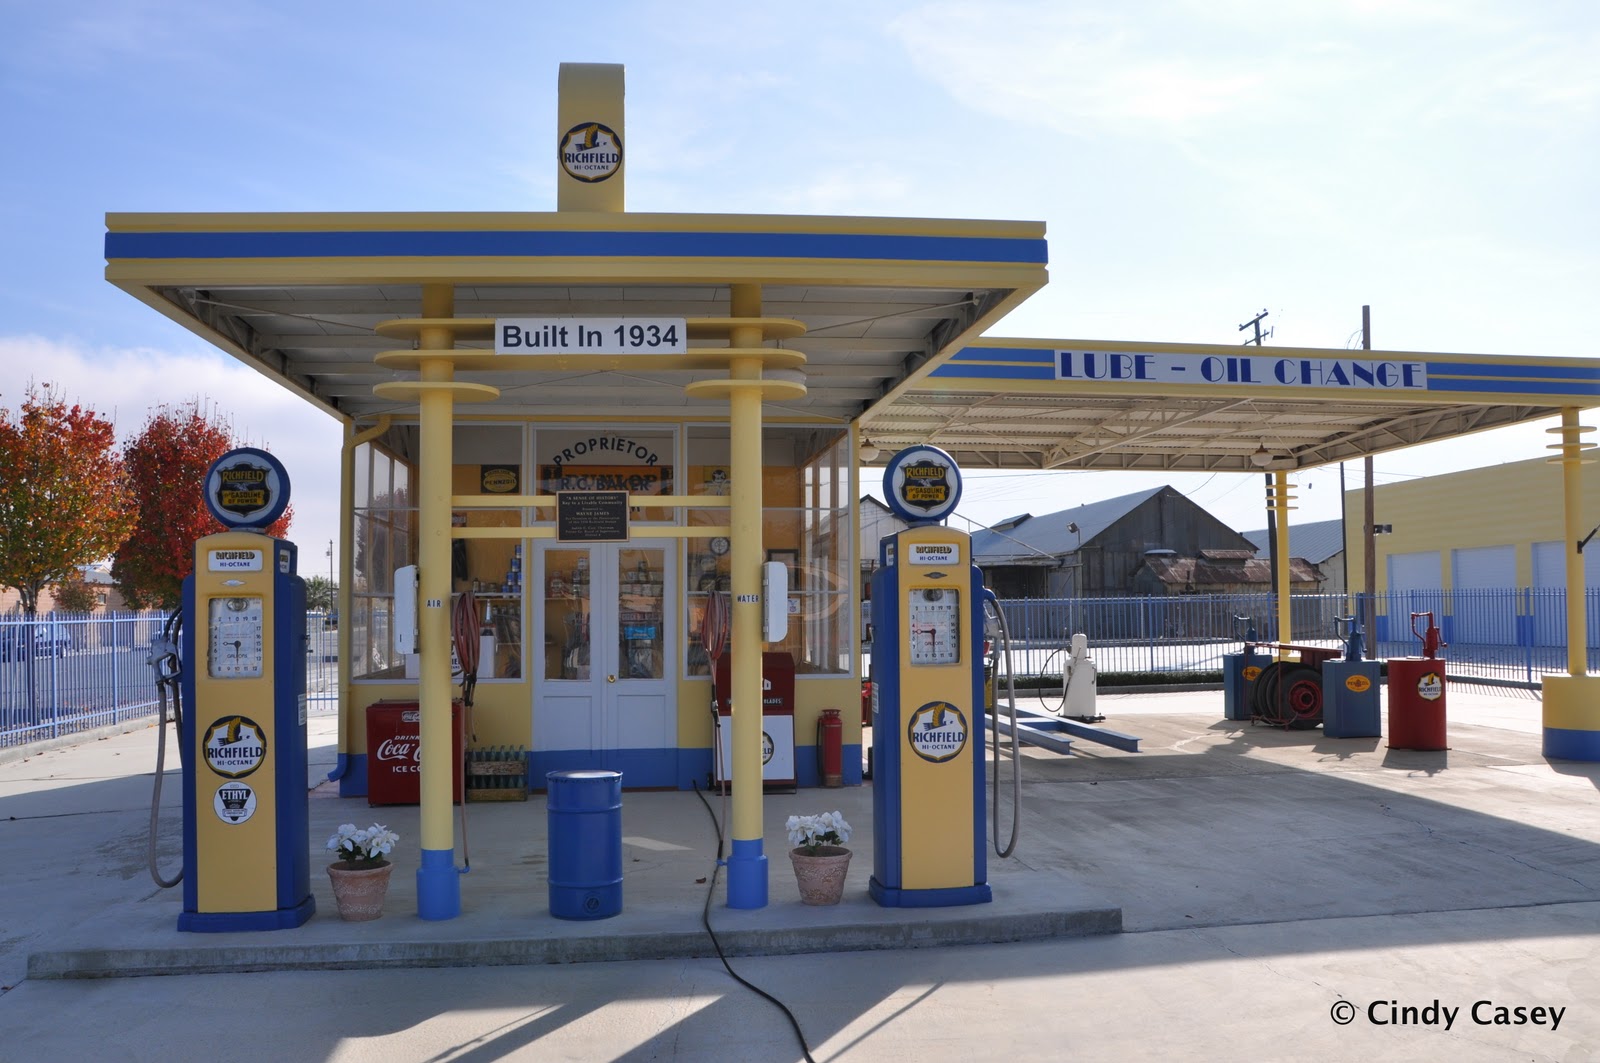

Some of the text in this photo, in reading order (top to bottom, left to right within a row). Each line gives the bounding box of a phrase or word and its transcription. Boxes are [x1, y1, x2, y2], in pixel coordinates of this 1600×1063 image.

[564, 152, 620, 164] RICHFIELD
[502, 324, 678, 348] Built In 1934
[1060, 352, 1156, 380] LUBE
[1200, 356, 1261, 383] OIL
[1274, 359, 1423, 388] CHANGE
[552, 436, 658, 467] PROPRIETOR
[222, 470, 264, 482] RICHFIELD
[906, 468, 945, 478] RICHFIELD
[596, 478, 650, 491] BAKER
[216, 552, 255, 560] RICHFIELD
[916, 546, 952, 554] RICHFIELD
[738, 595, 759, 603] WATER
[912, 732, 966, 743] RICHFIELD
[208, 746, 263, 758] RICHFIELD
[222, 790, 248, 800] ETHYL
